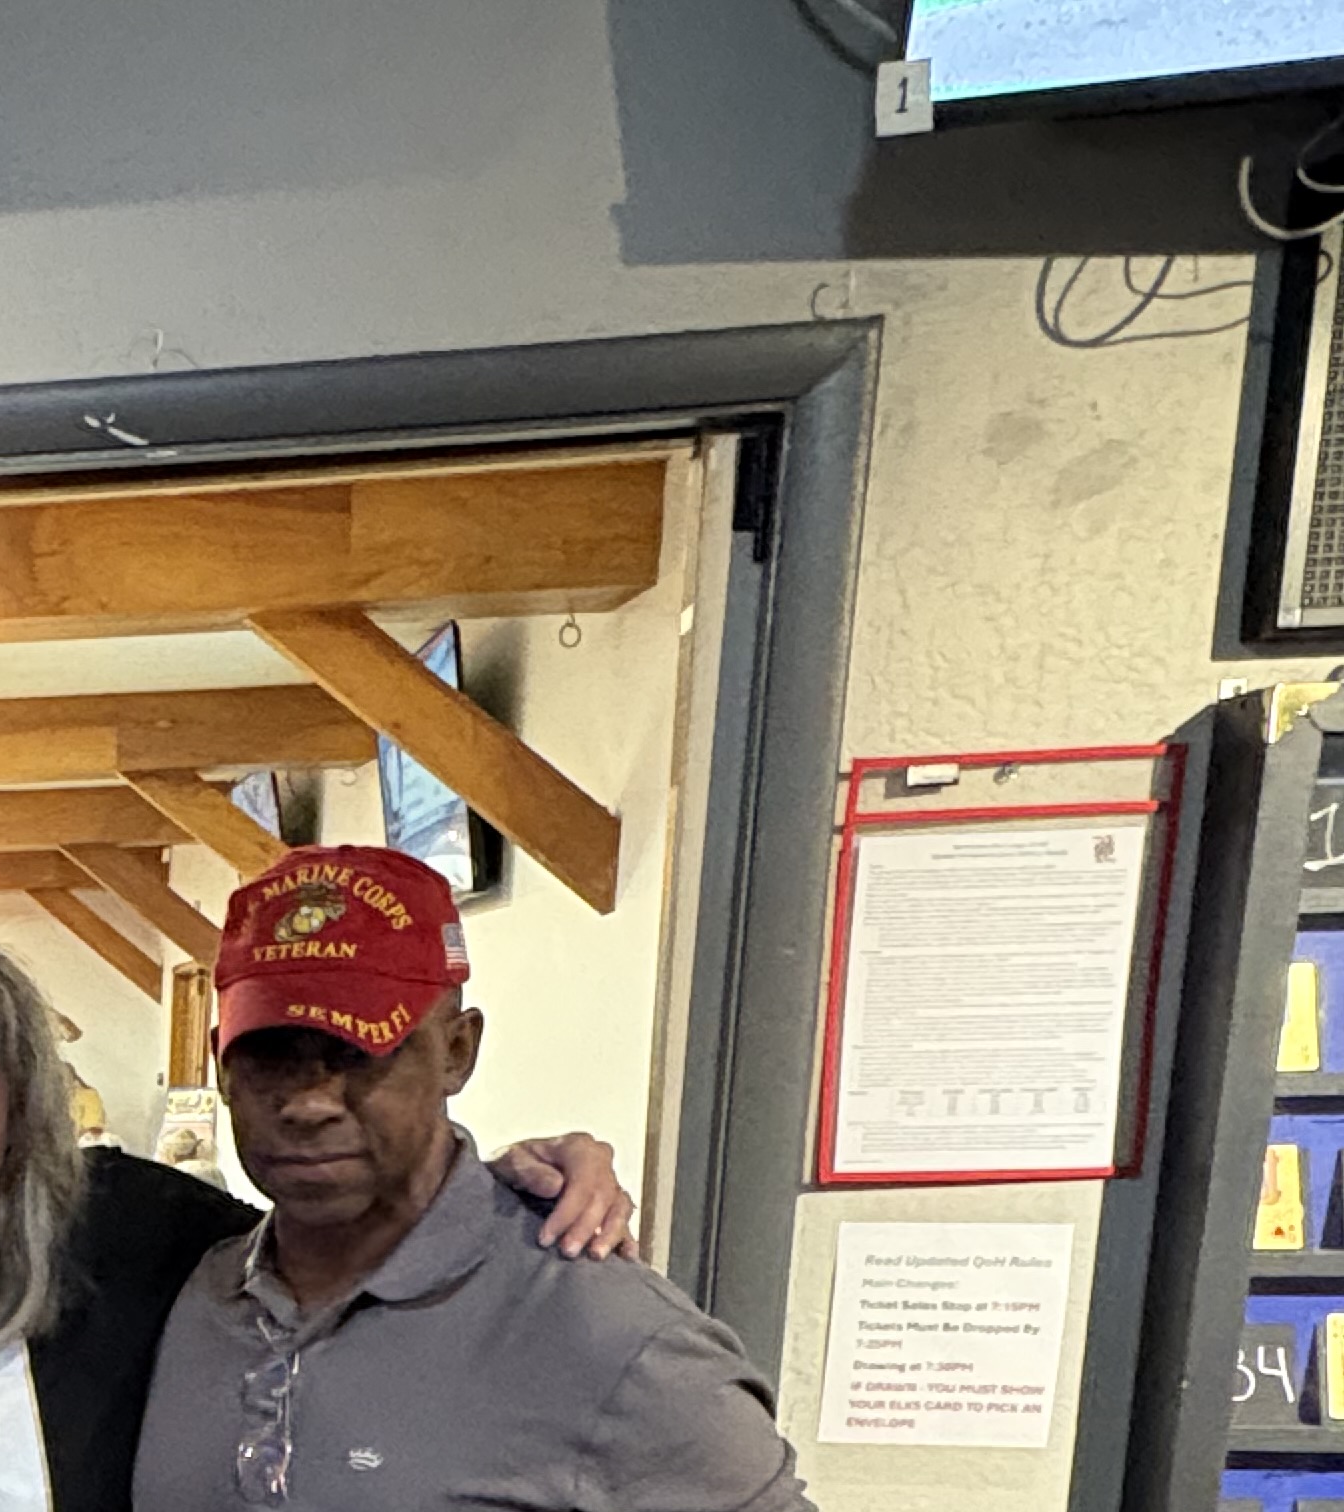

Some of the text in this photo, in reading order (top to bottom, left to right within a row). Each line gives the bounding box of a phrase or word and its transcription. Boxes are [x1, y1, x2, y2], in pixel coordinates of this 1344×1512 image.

[895, 76, 910, 114] 1
[262, 863, 413, 931] MARINE CORPS
[252, 940, 358, 962] VETERAN
[286, 1002, 412, 1044] SEMPER FI
[864, 1254, 903, 1267] Read
[905, 1255, 970, 1269] Updated
[1009, 1257, 1053, 1268] Rules
[859, 1300, 898, 1310] Ticket
[902, 1301, 938, 1311] Sales
[941, 1301, 972, 1312] Stop
[858, 1320, 903, 1332] Tickets
[906, 1321, 939, 1332] Must
[942, 1322, 959, 1332] Be
[962, 1322, 1020, 1335] Dropped
[852, 1360, 906, 1372] Drawing
[927, 1383, 956, 1394] YOU
[959, 1384, 998, 1395] MUST
[1000, 1384, 1045, 1396] SHOW
[848, 1399, 1042, 1414] YOUR ELKS CARD TO PICK AN
[845, 1416, 916, 1428] ENVELOPE
